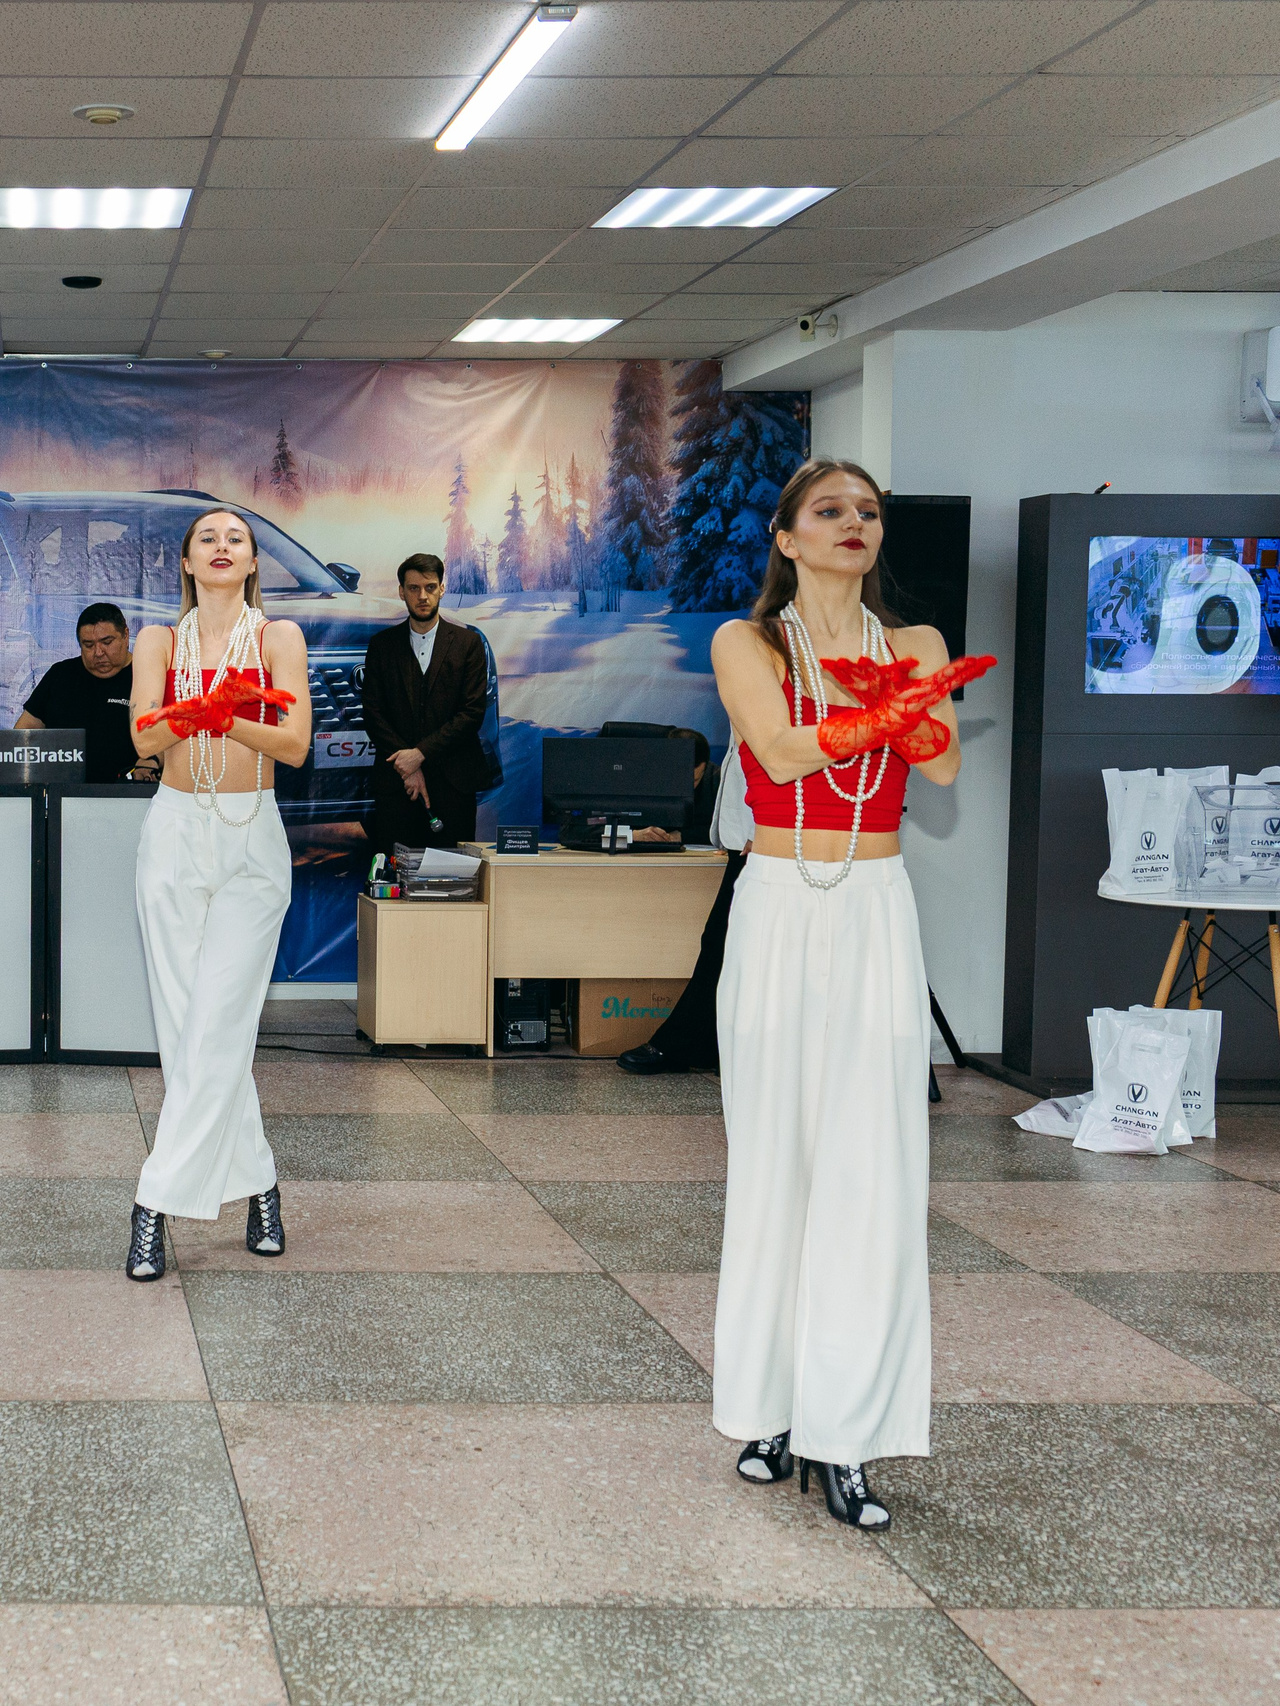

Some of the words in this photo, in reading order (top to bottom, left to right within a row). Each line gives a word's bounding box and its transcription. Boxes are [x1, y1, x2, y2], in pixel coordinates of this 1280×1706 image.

[1161, 652, 1215, 660] Полностью
[1130, 661, 1182, 670] сборочный
[1183, 662, 1211, 670] робот
[1115, 1104, 1159, 1118] CHANGAN
[1110, 1116, 1158, 1131] Агат-Авто
